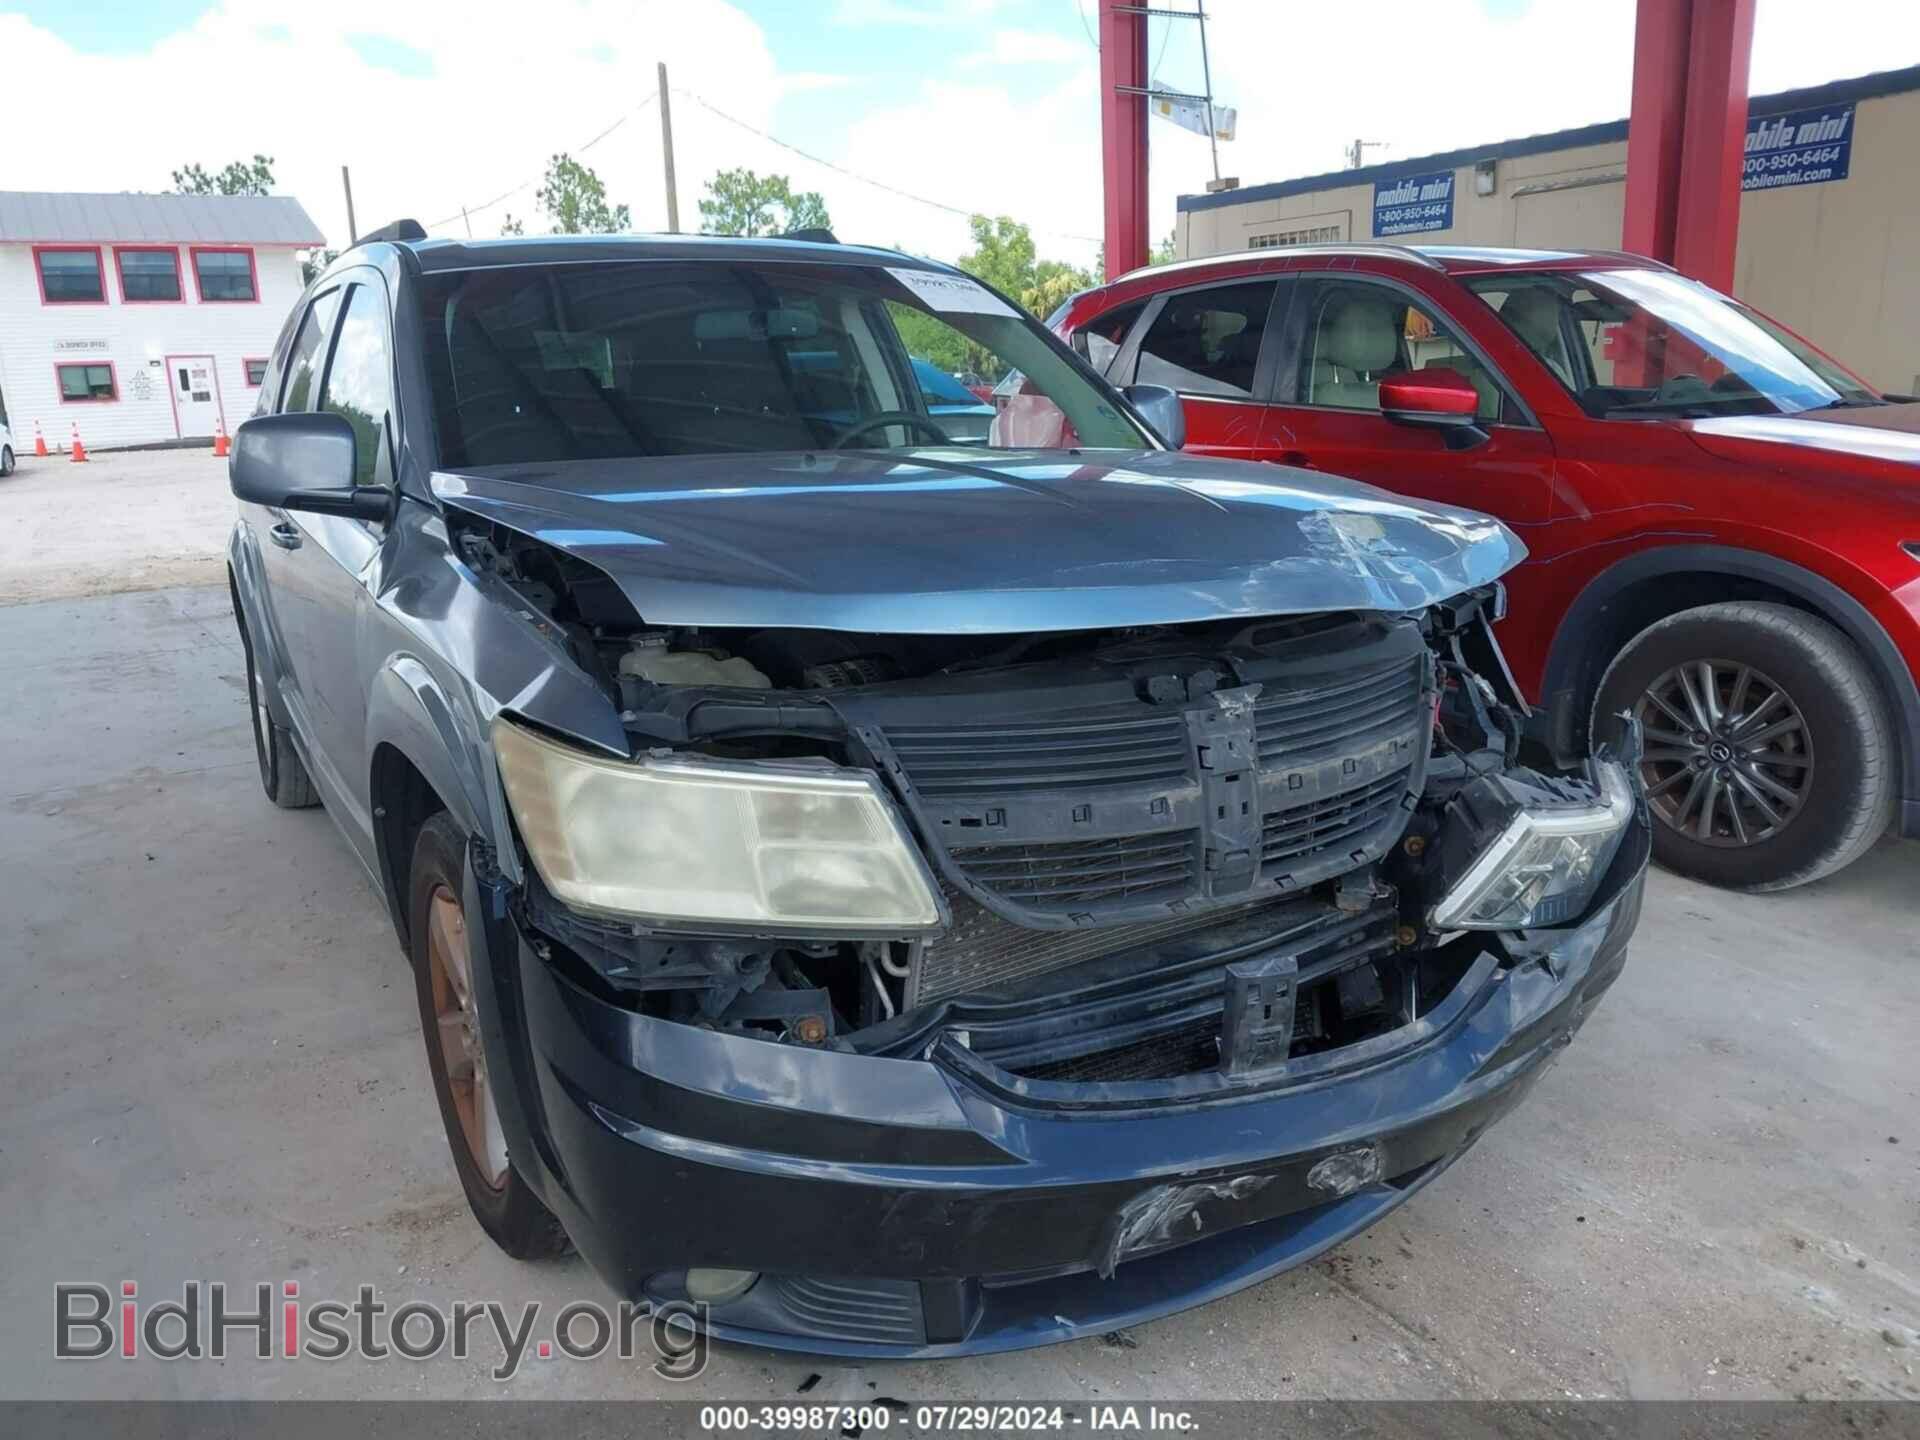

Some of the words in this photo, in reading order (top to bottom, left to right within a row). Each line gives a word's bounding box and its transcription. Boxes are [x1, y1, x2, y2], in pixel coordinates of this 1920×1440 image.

[1744, 118, 1795, 152] obile
[1794, 111, 1850, 145] mini
[1376, 180, 1420, 207] mobile
[1420, 177, 1452, 201] mini
[1381, 220, 1443, 235] mobilemini.com
